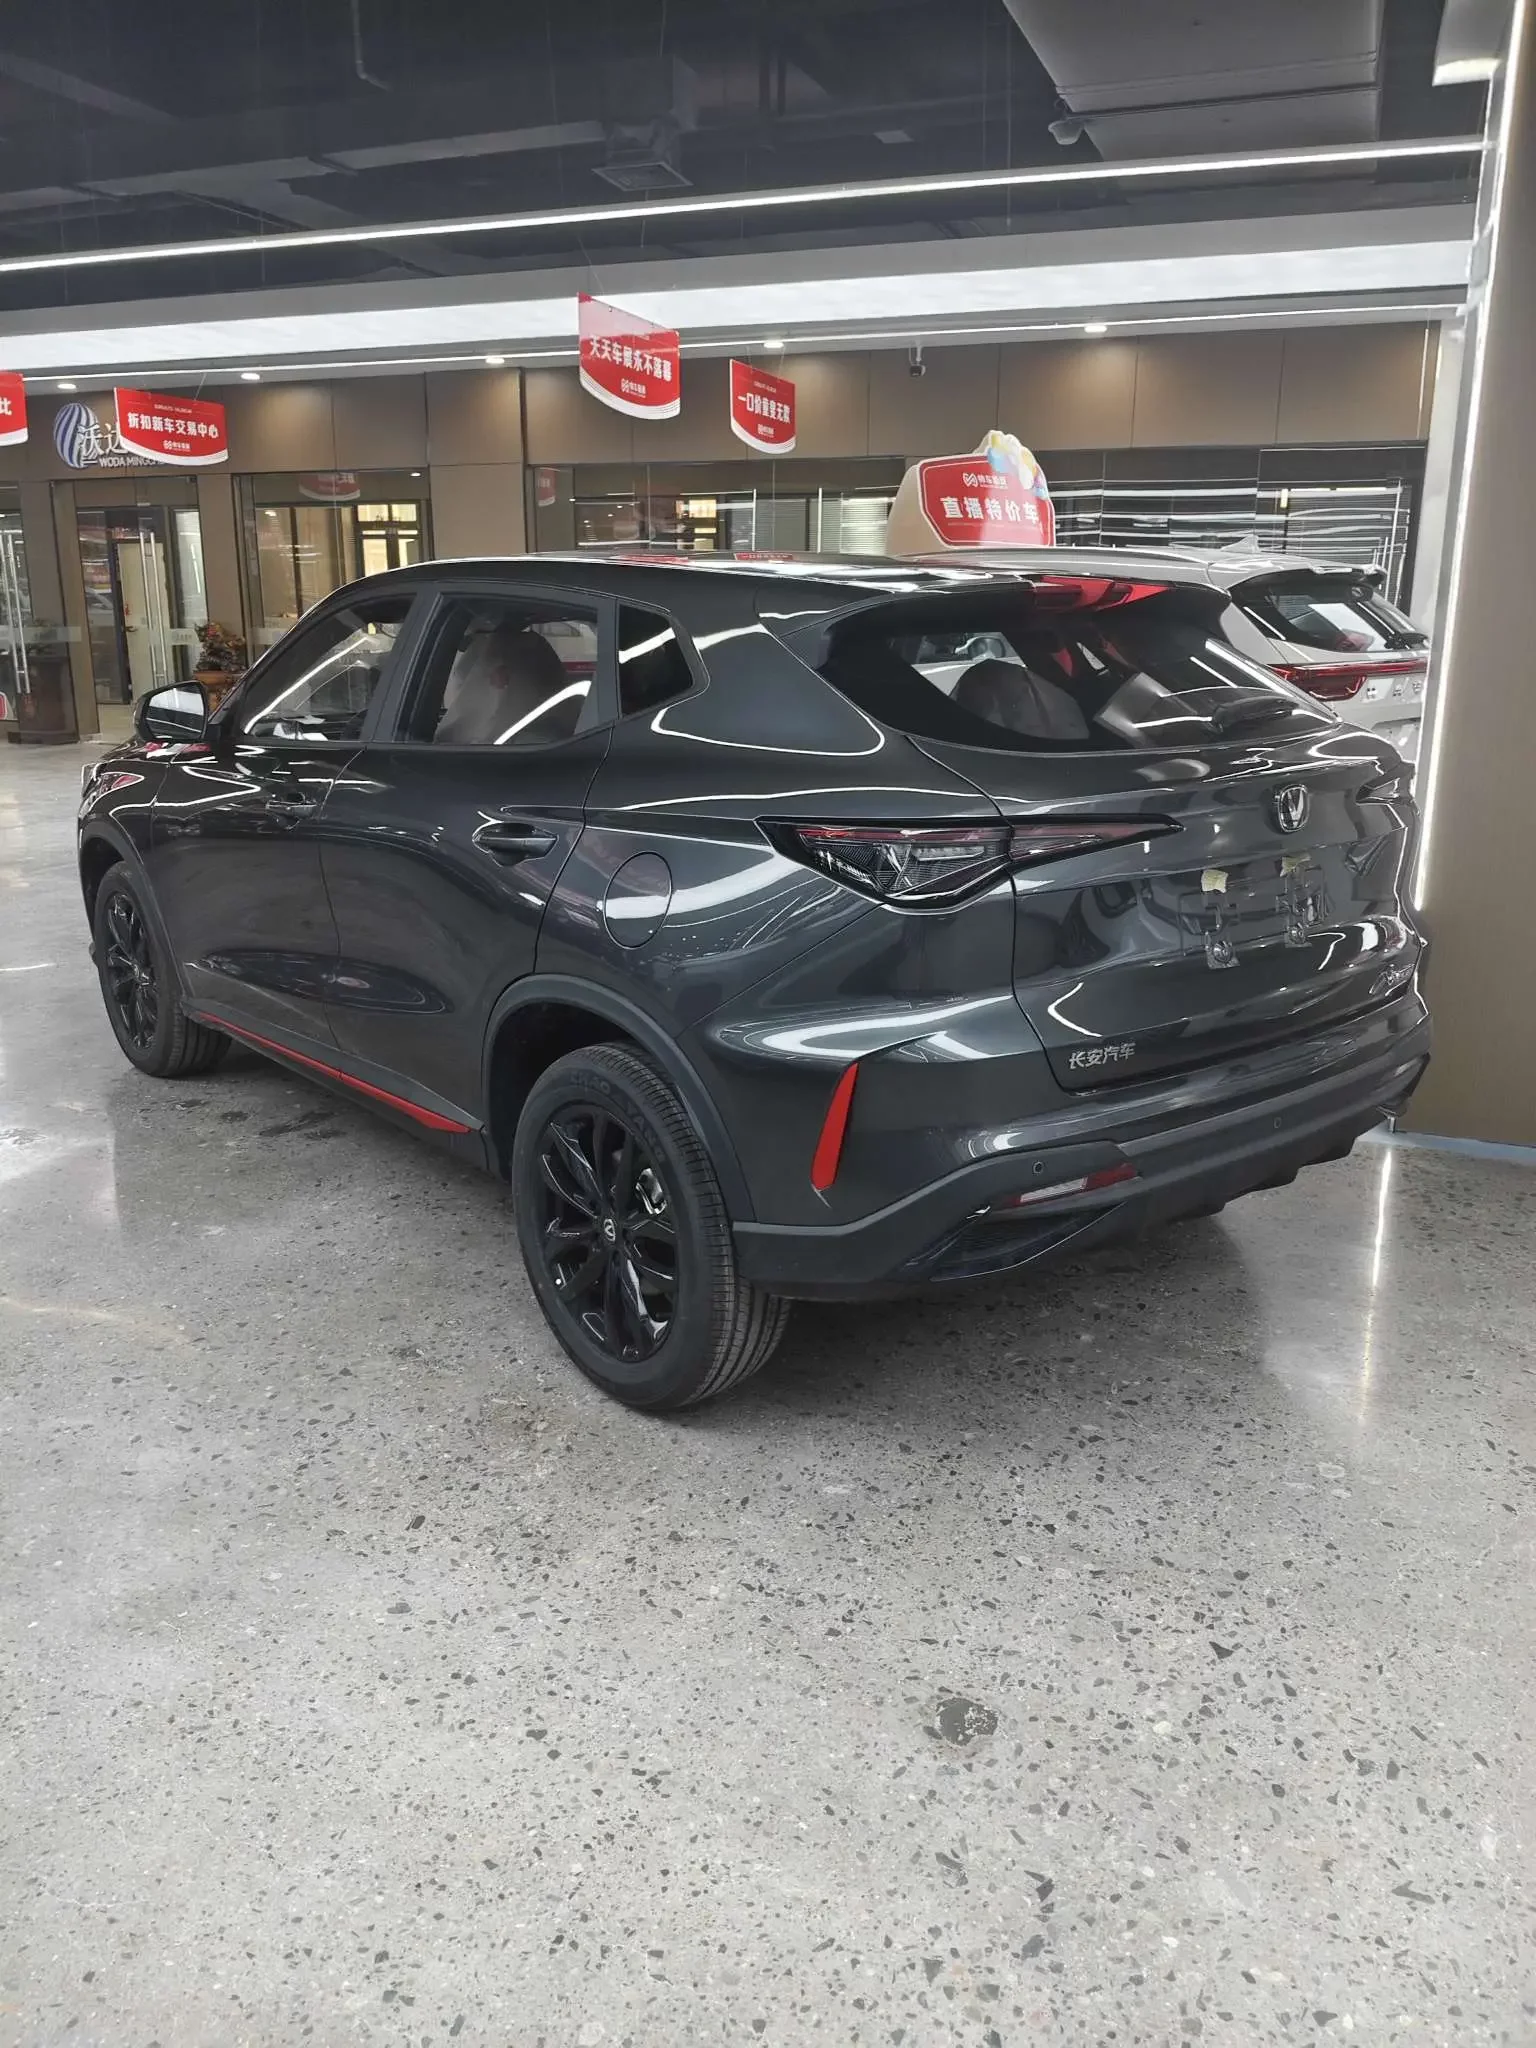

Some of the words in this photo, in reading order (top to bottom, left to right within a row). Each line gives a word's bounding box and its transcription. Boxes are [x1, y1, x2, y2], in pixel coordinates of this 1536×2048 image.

[127, 412, 219, 439] 折扣新车交易中心
[98, 457, 126, 468] WODA
[940, 496, 1040, 524] 直播特价车
[1069, 1042, 1136, 1069] 长安汽车
